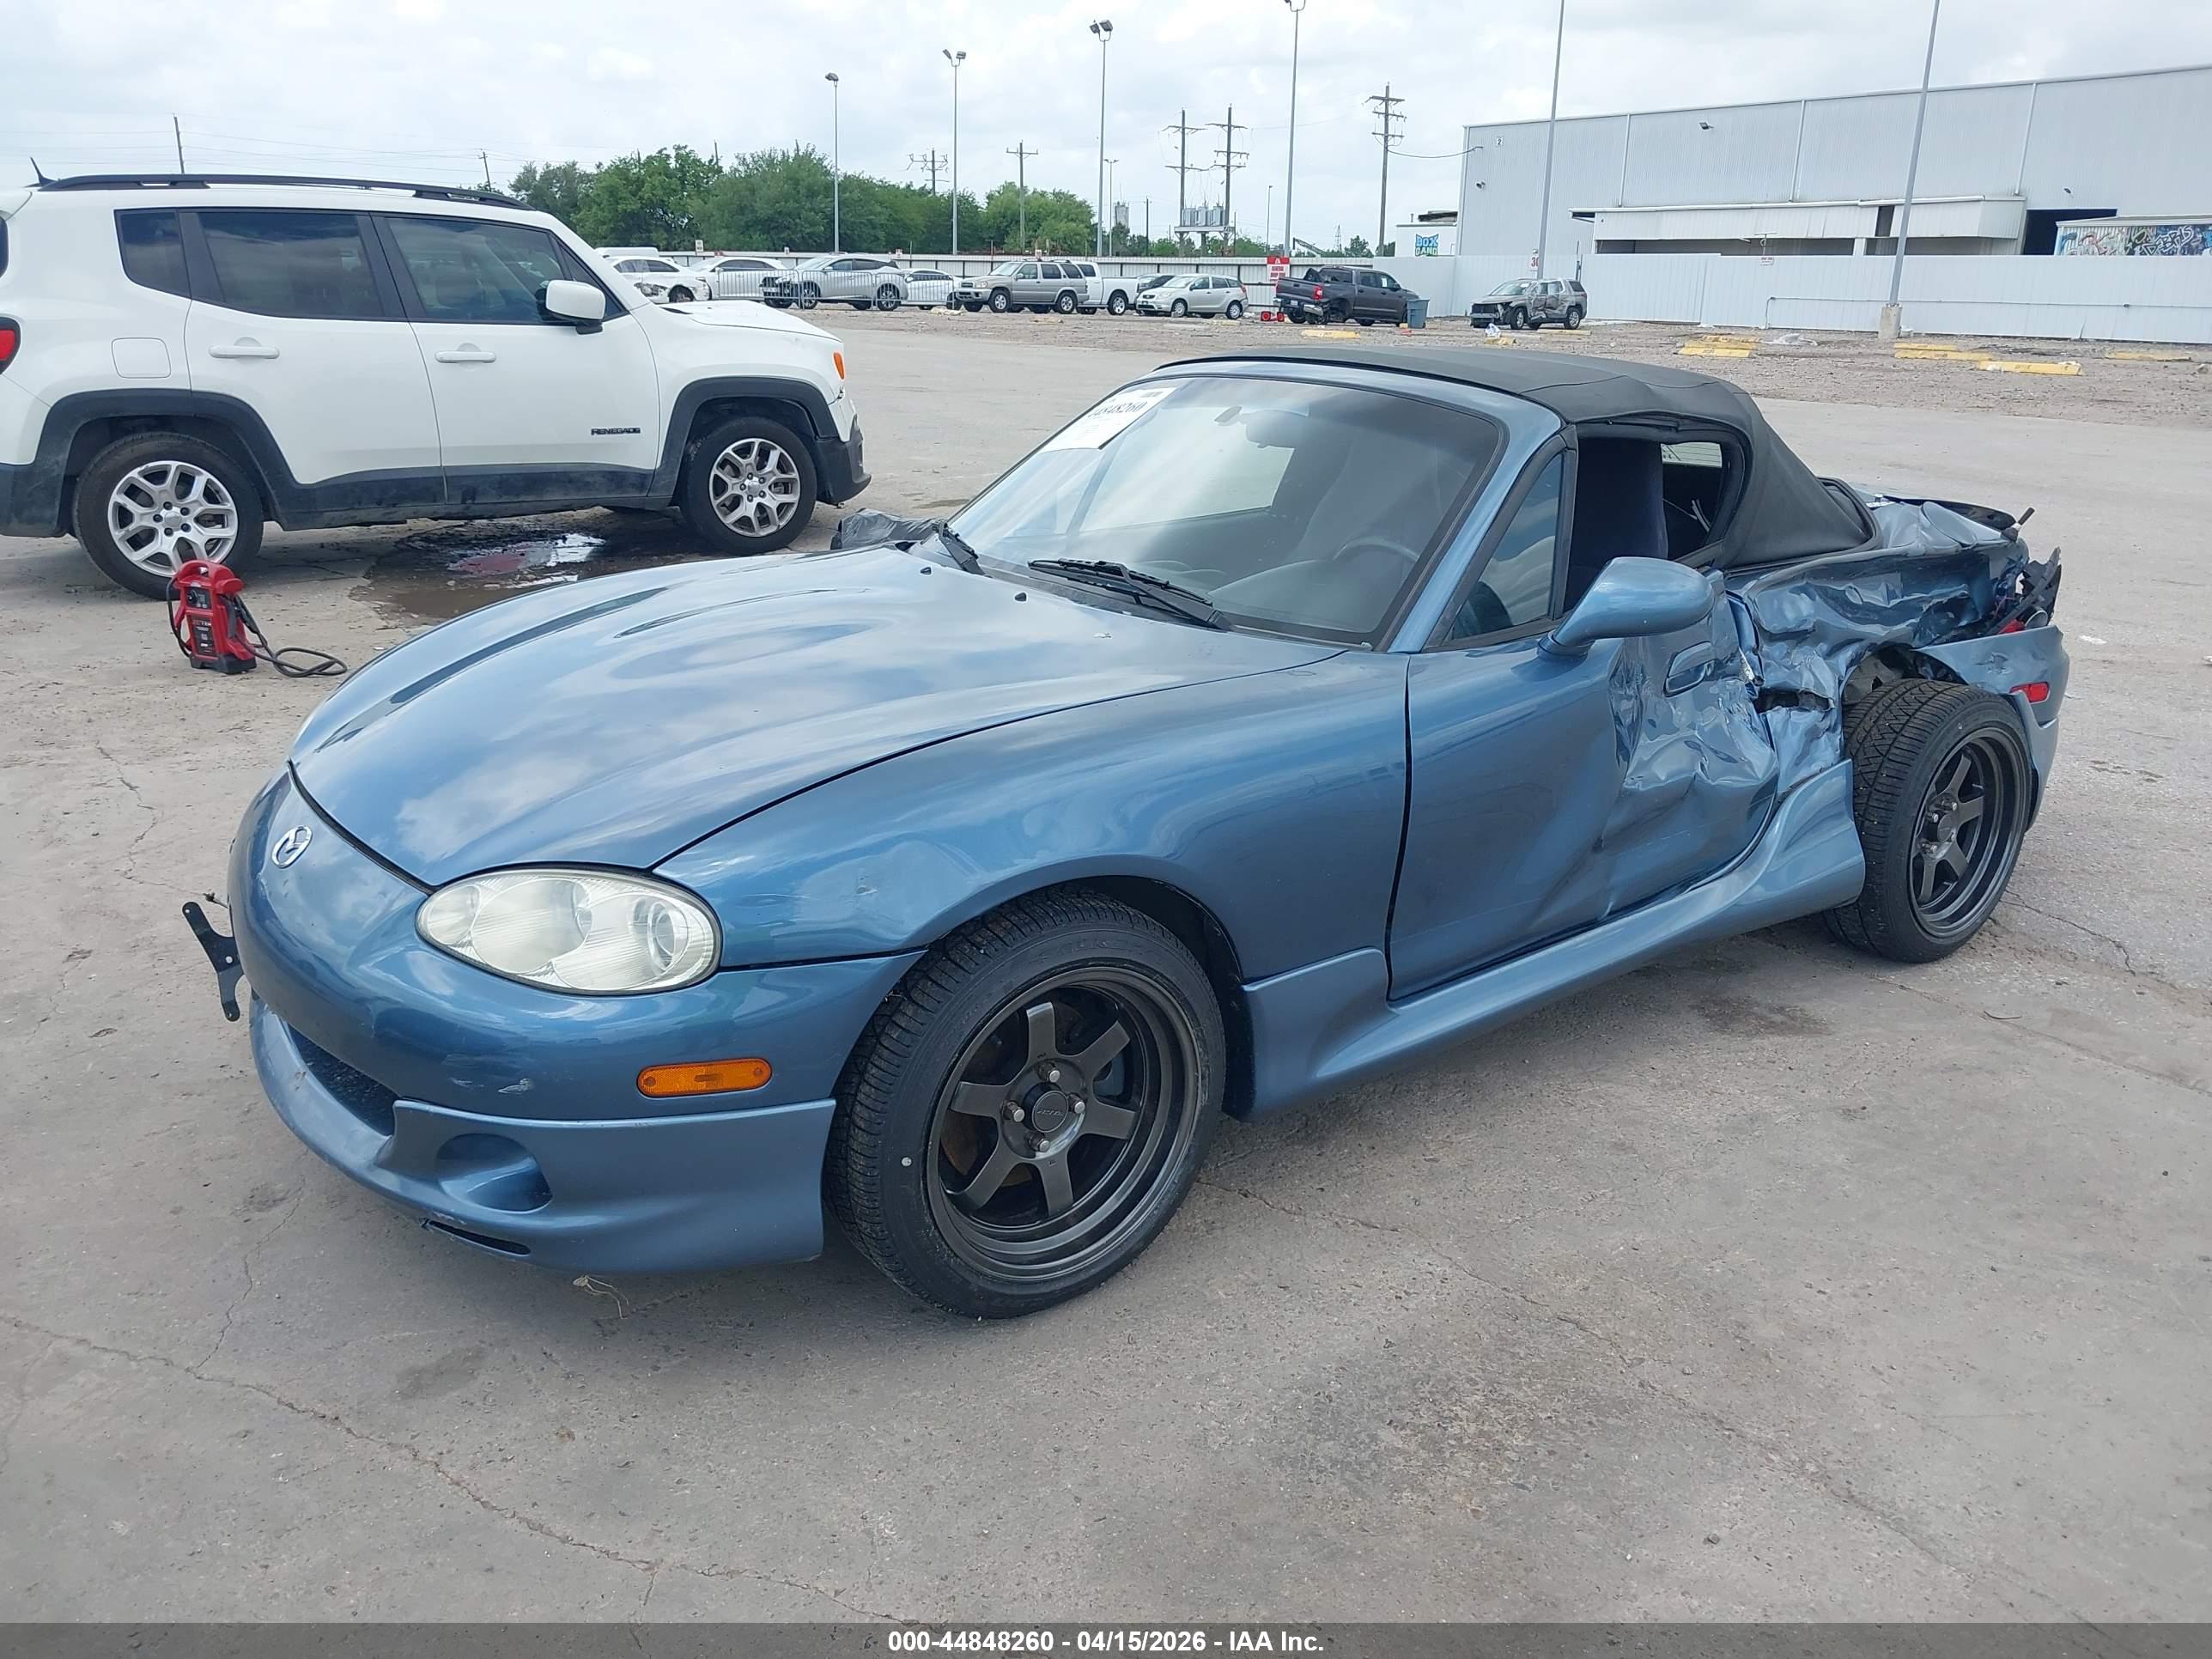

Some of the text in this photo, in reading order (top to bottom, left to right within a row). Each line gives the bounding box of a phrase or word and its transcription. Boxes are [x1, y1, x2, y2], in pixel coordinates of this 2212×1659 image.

[1416, 234, 1438, 247] BOX
[1415, 246, 1437, 255] GANG
[591, 427, 641, 435] RENEGADE
